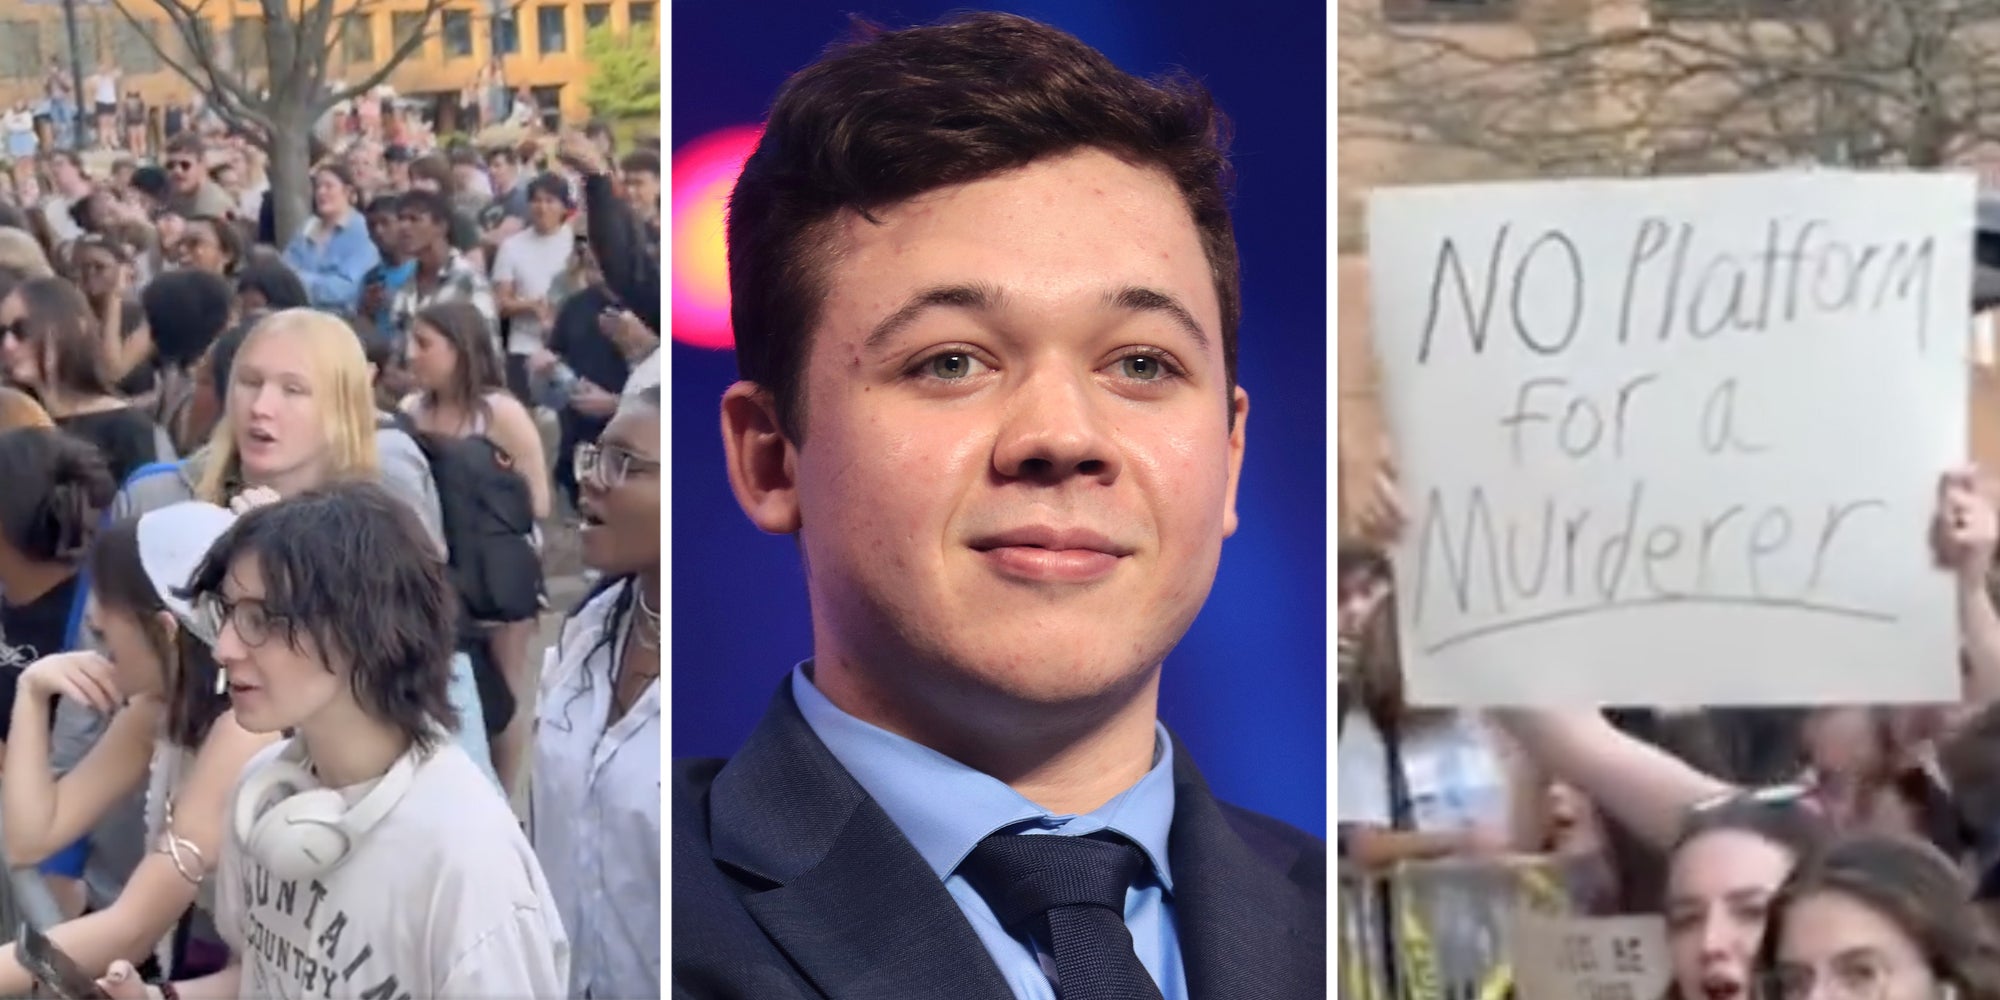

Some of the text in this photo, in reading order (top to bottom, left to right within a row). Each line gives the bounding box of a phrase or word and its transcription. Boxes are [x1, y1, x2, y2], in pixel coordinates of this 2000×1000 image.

[1417, 221, 1584, 365] NO
[1501, 374, 1774, 464] for a
[1413, 479, 1886, 628] Murderer
